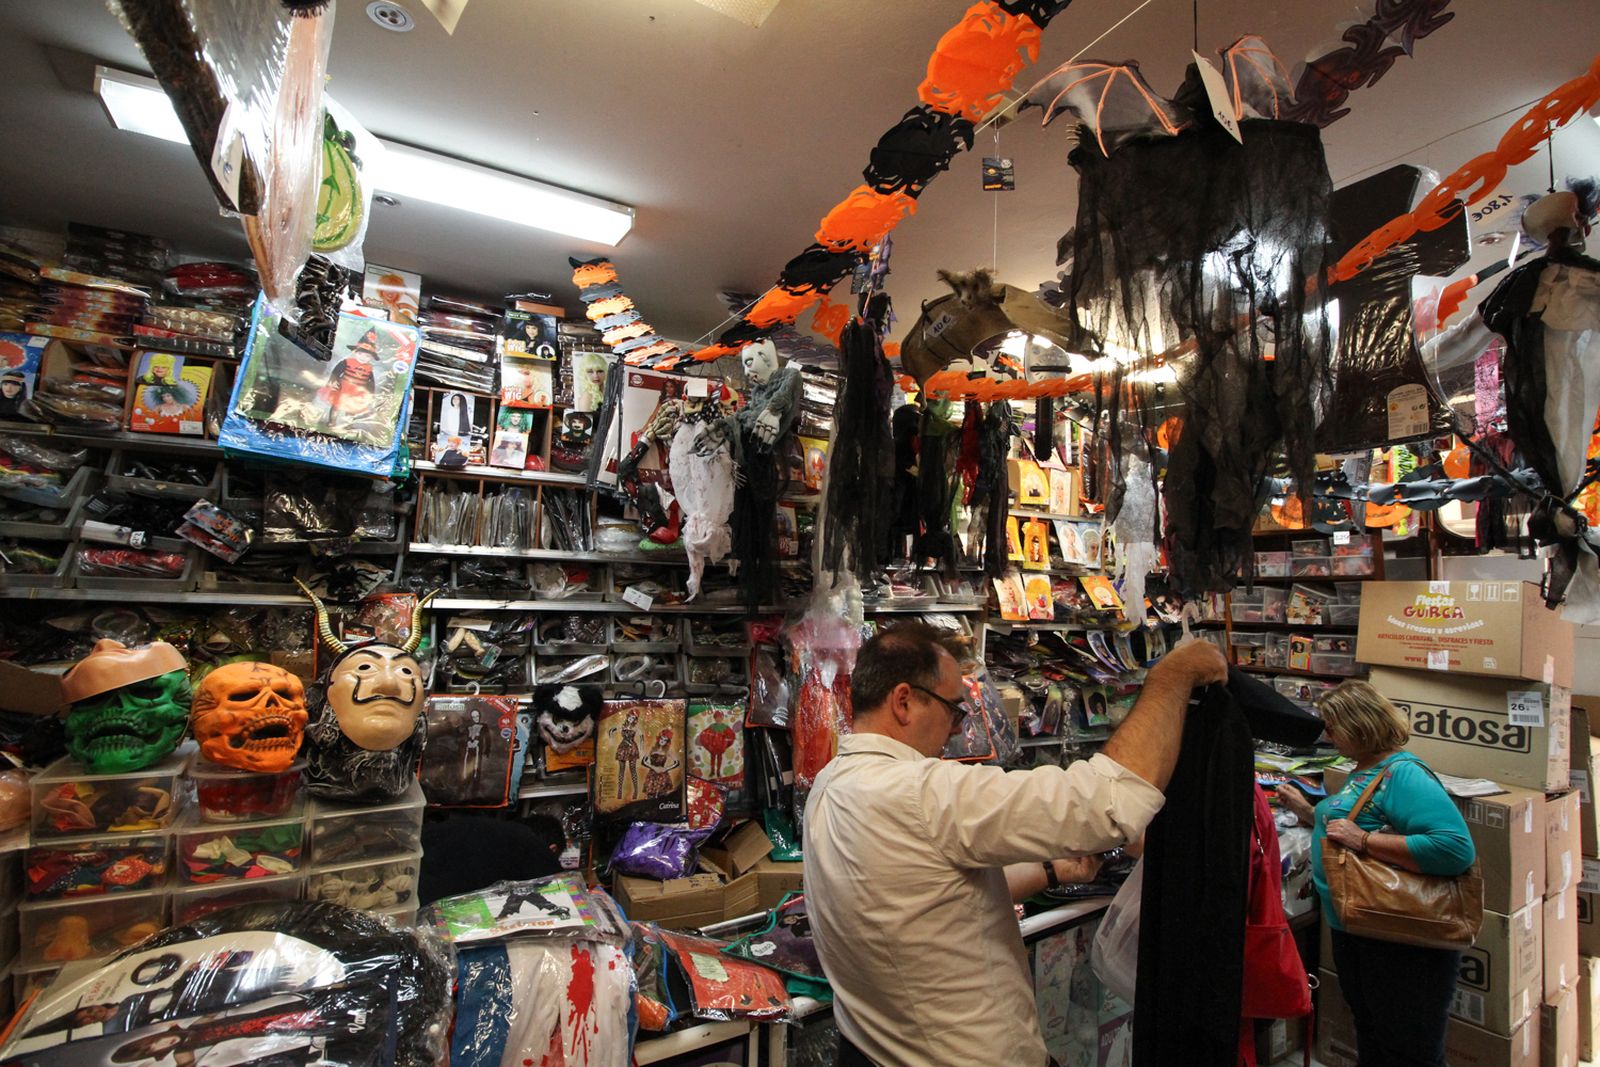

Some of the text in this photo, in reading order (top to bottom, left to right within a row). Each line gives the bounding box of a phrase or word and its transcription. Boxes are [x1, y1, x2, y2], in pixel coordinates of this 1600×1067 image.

[507, 342, 526, 353] WIG
[504, 391, 522, 400] WIG
[1415, 594, 1456, 607] Fiestas
[1413, 709, 1526, 749] atosa
